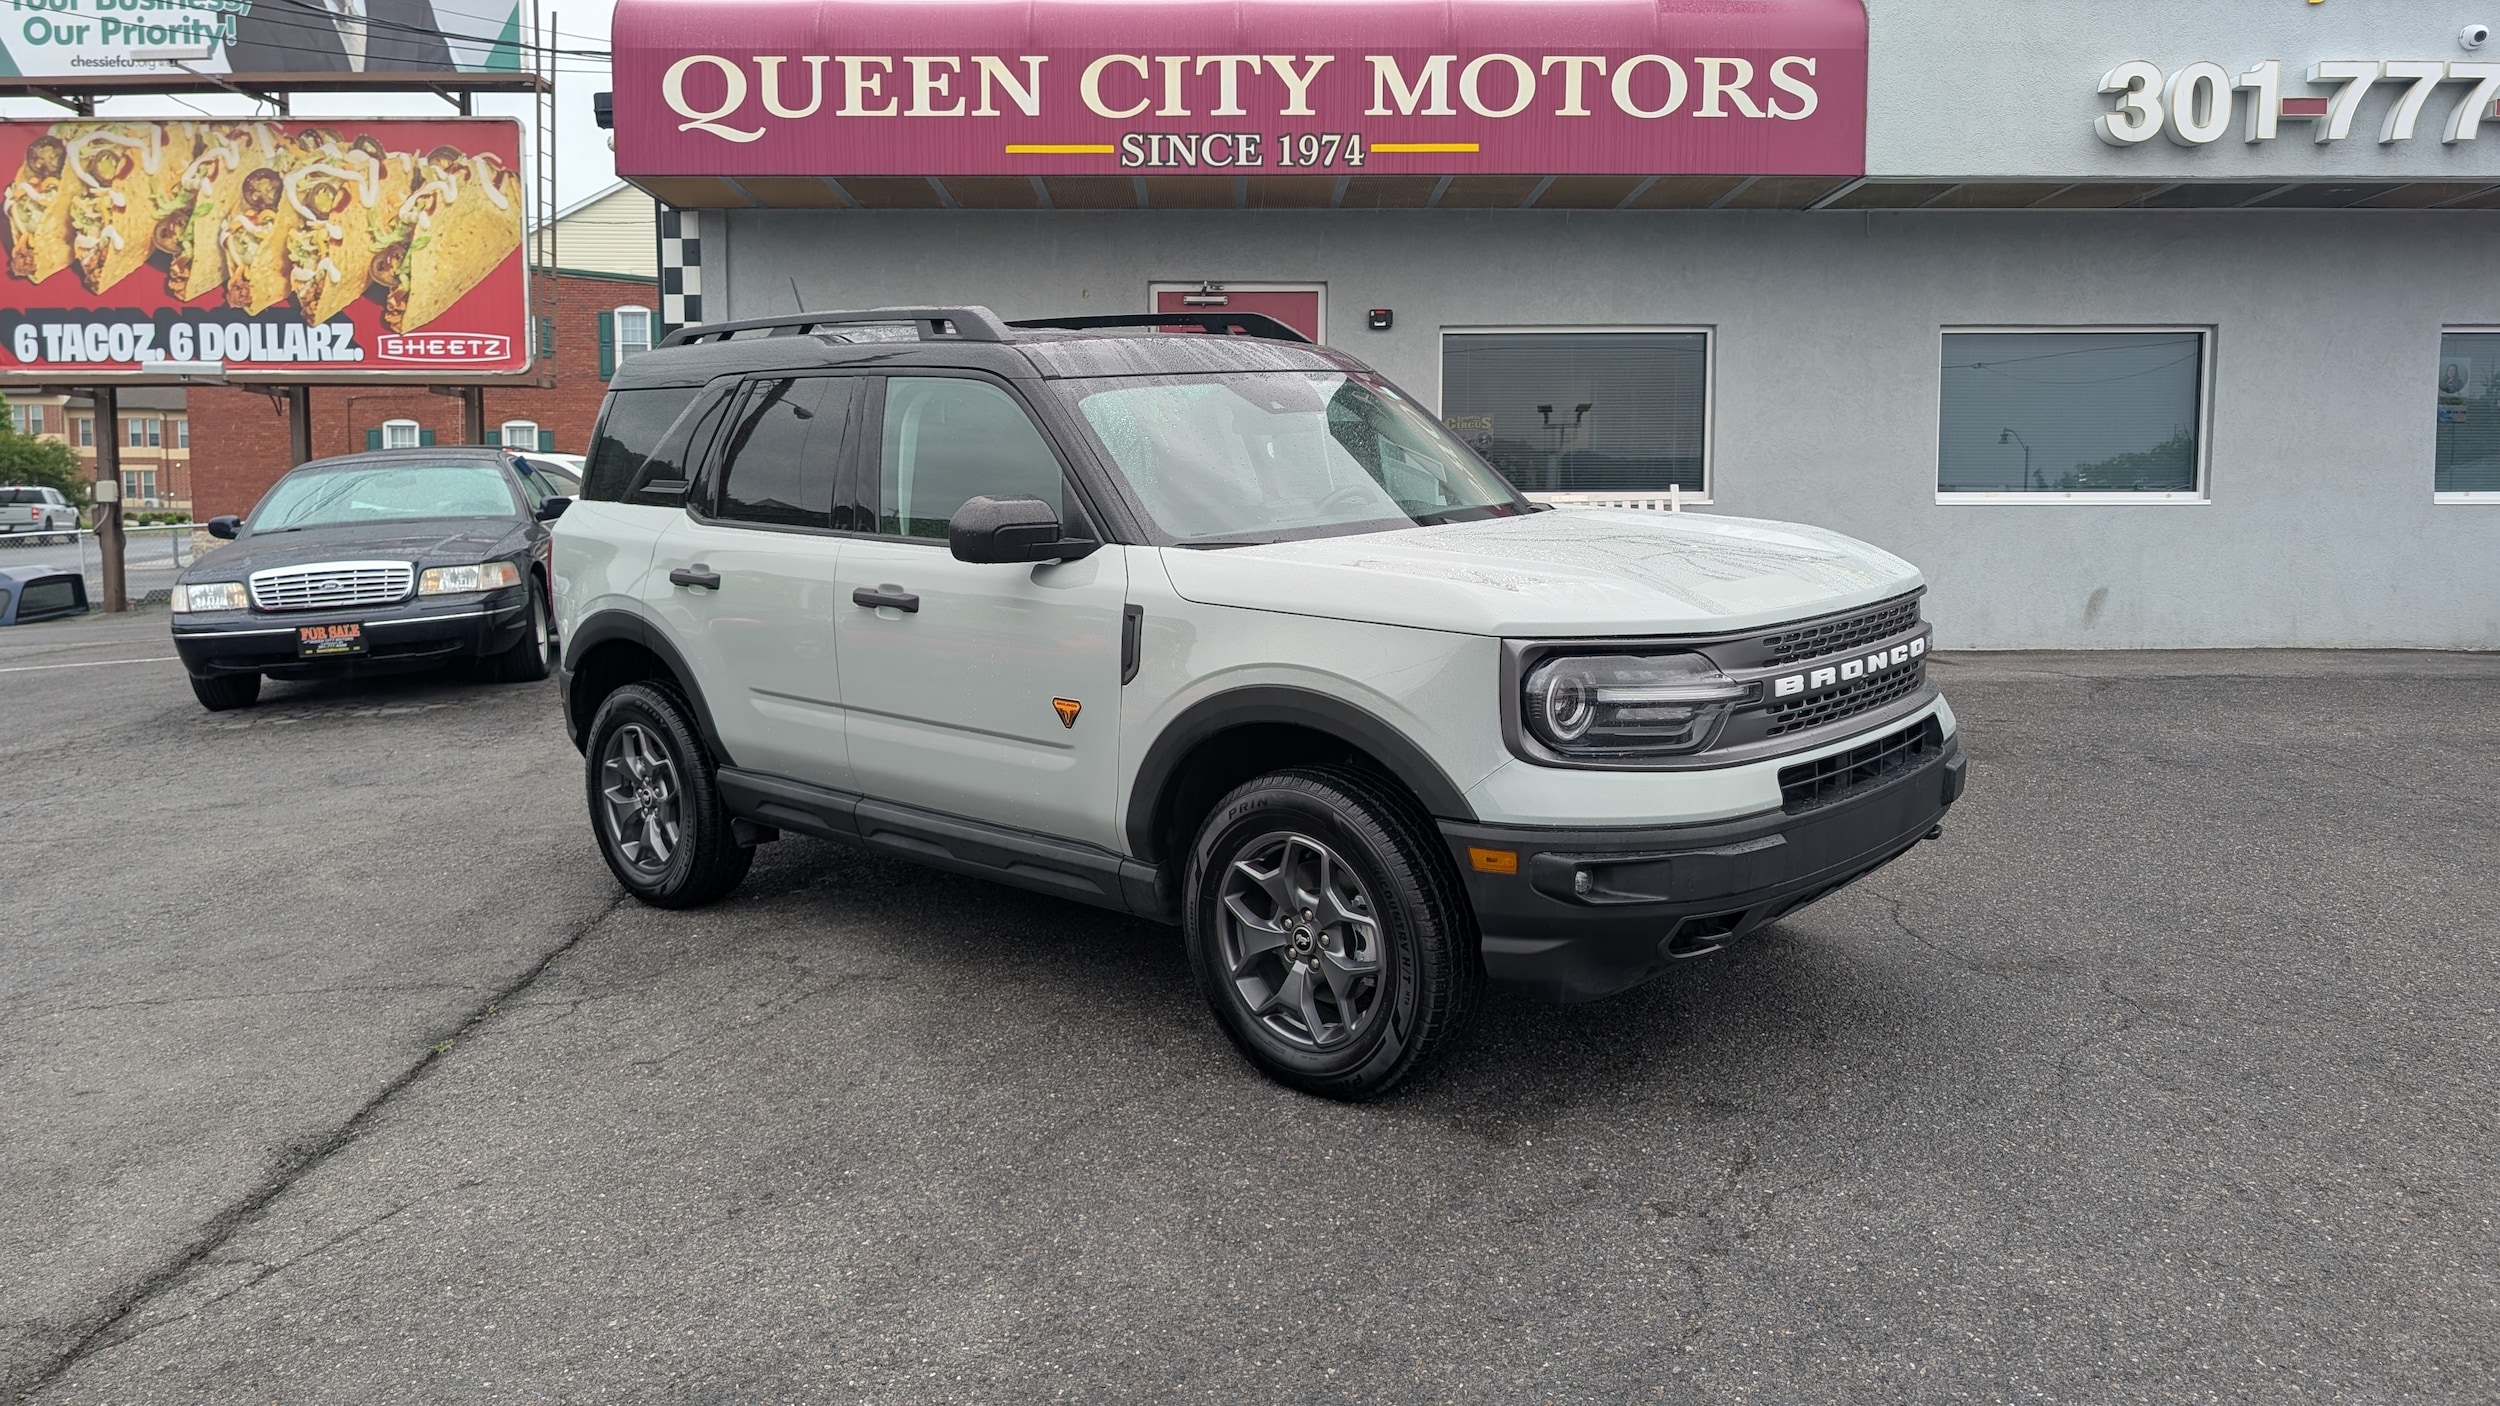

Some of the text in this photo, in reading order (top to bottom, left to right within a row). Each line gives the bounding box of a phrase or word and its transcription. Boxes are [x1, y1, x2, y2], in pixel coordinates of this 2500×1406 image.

[23, 15, 237, 54] Our Priority!
[662, 53, 1819, 143] QUEEN CITY MOTORS
[2095, 59, 2500, 146] 301-777
[1120, 133, 1366, 168] SINCE 1974
[14, 322, 364, 363] 6 TACOZ. 6 DOLLARZ.
[387, 340, 501, 356] SHEETZ
[1445, 417, 1492, 429] CIRCUS
[300, 624, 361, 640] FOR SALE
[1775, 637, 1925, 697] BRONCO
